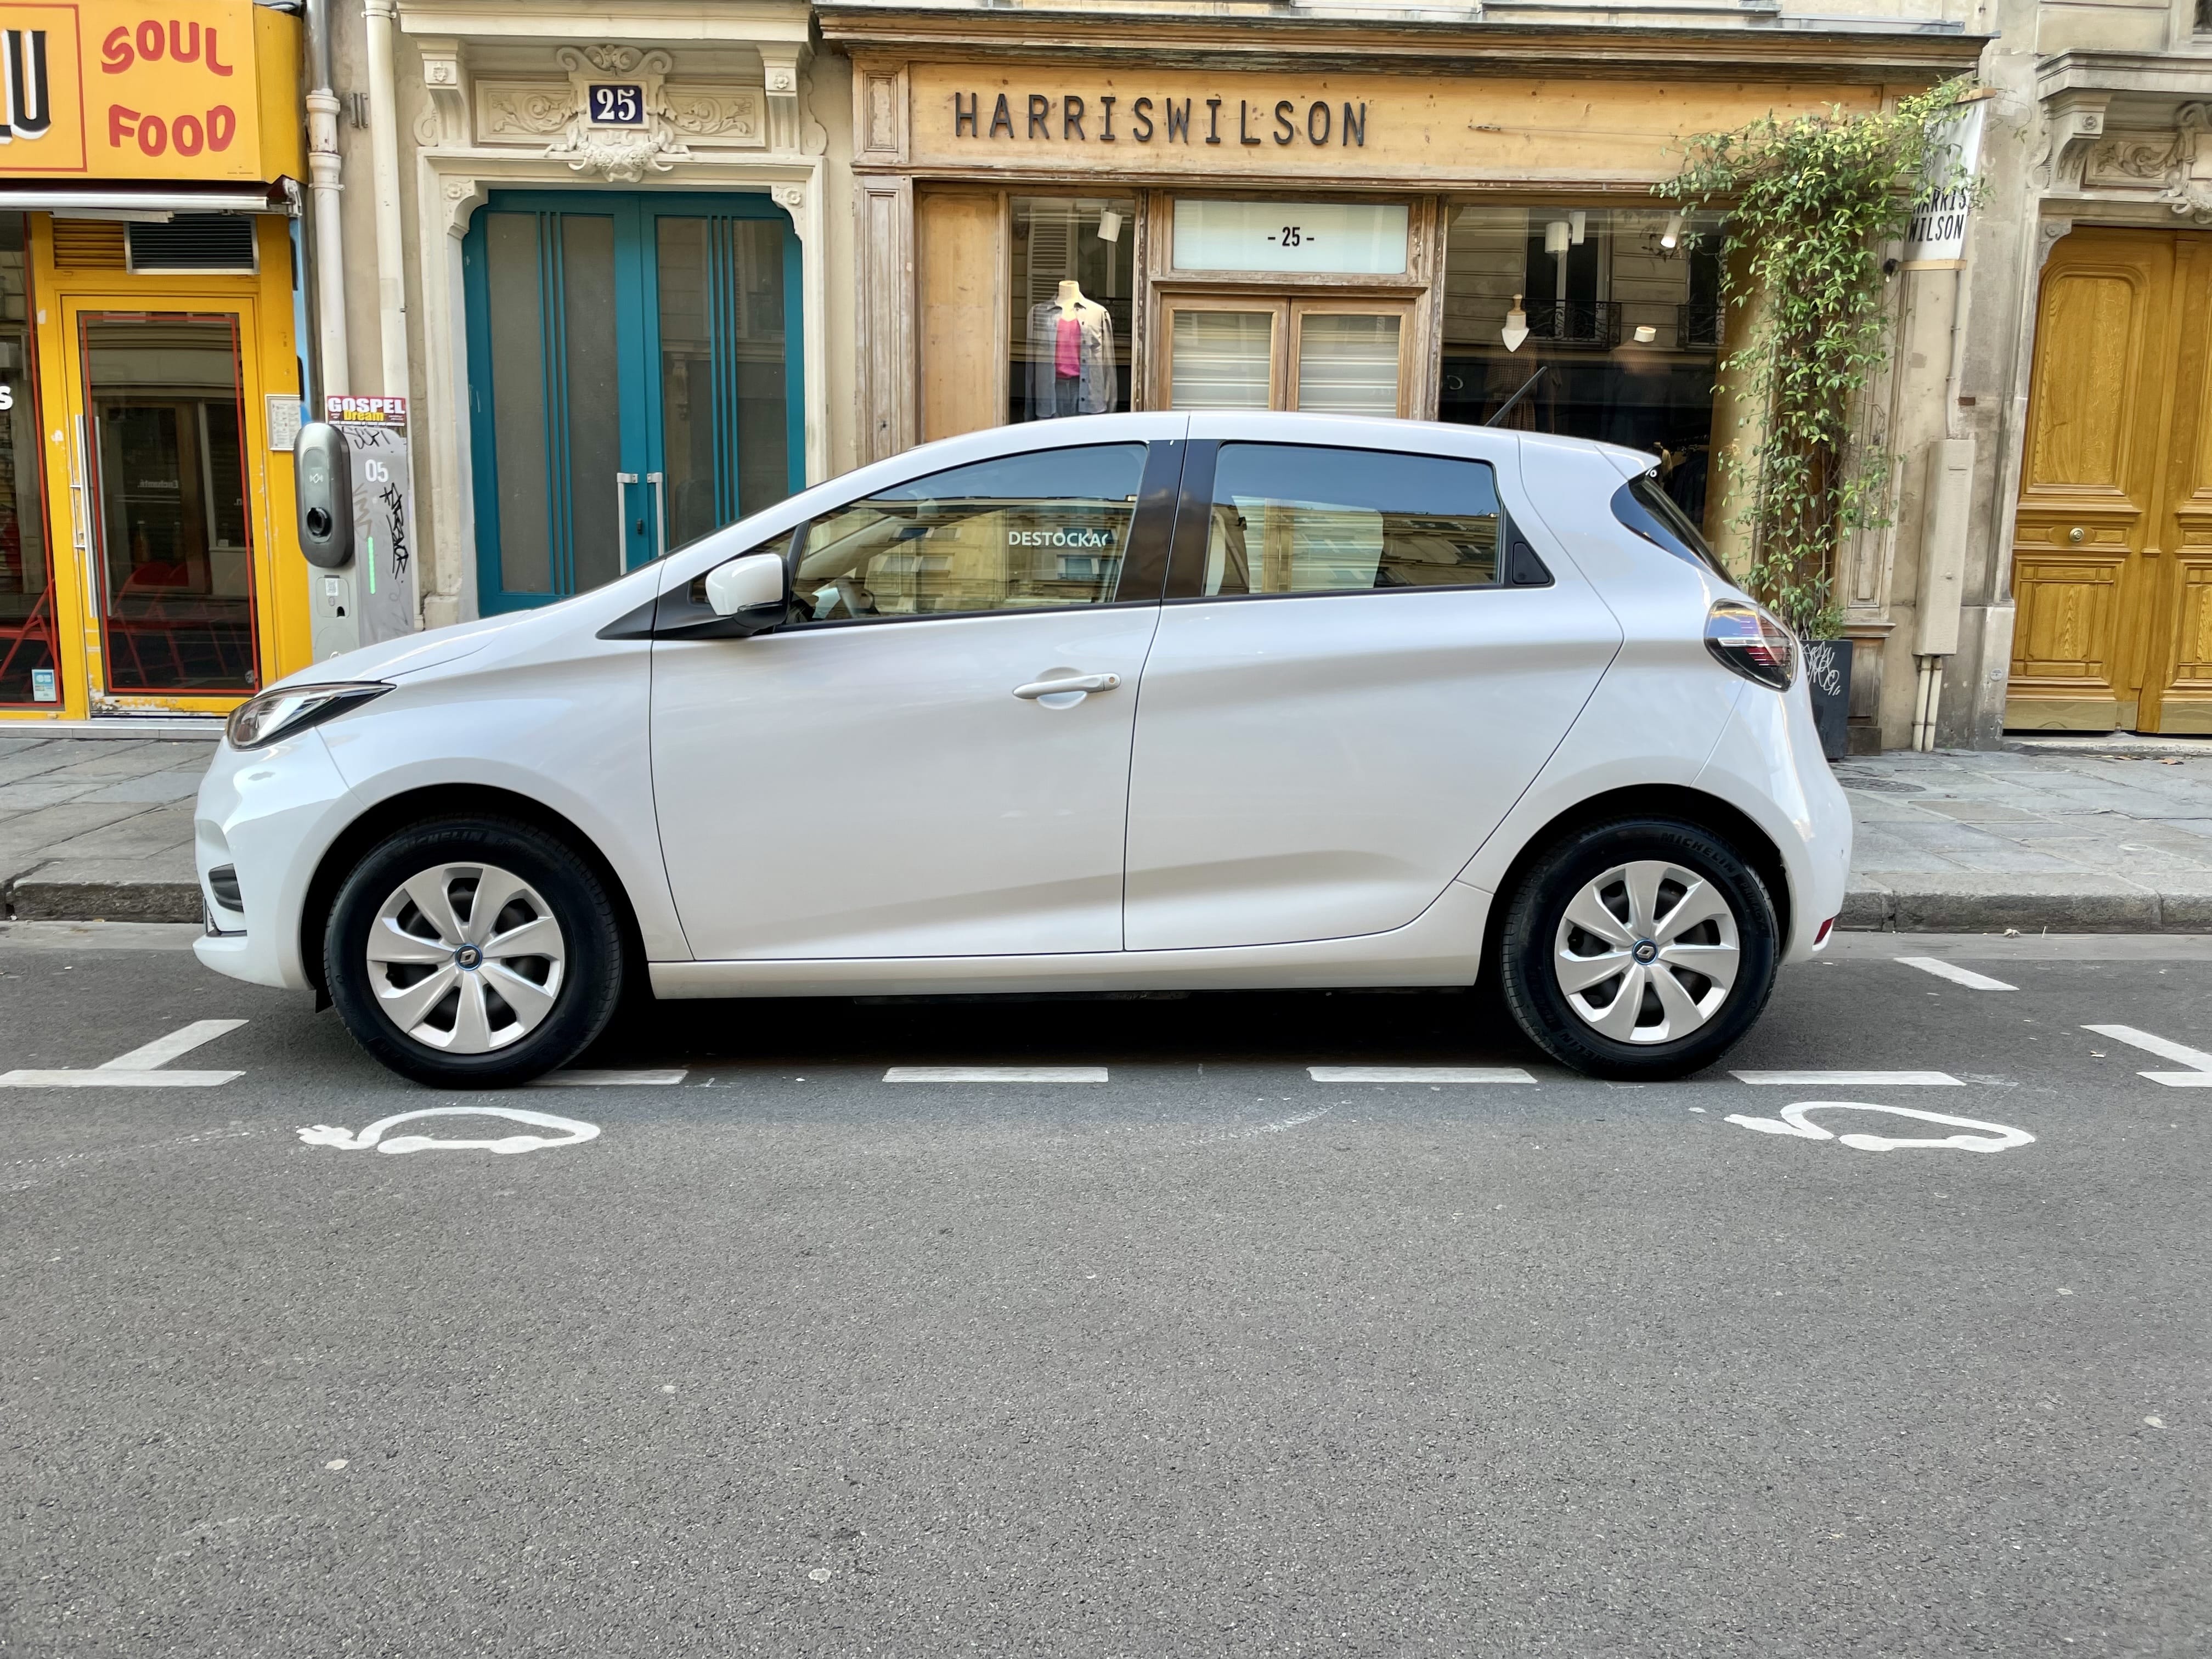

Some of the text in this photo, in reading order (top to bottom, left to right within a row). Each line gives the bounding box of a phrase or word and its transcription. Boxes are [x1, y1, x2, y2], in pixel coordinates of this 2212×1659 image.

[101, 20, 233, 76] SOUL
[0, 29, 52, 144] U
[596, 88, 636, 121] 25
[109, 104, 236, 157] FOOD
[955, 92, 1365, 147] HARRISWILSON
[1908, 214, 1964, 242] WILSON
[328, 397, 405, 414] GOSPEL
[343, 410, 384, 421] Dream
[365, 459, 389, 483] 05
[1660, 832, 1735, 873] MICHELIN
